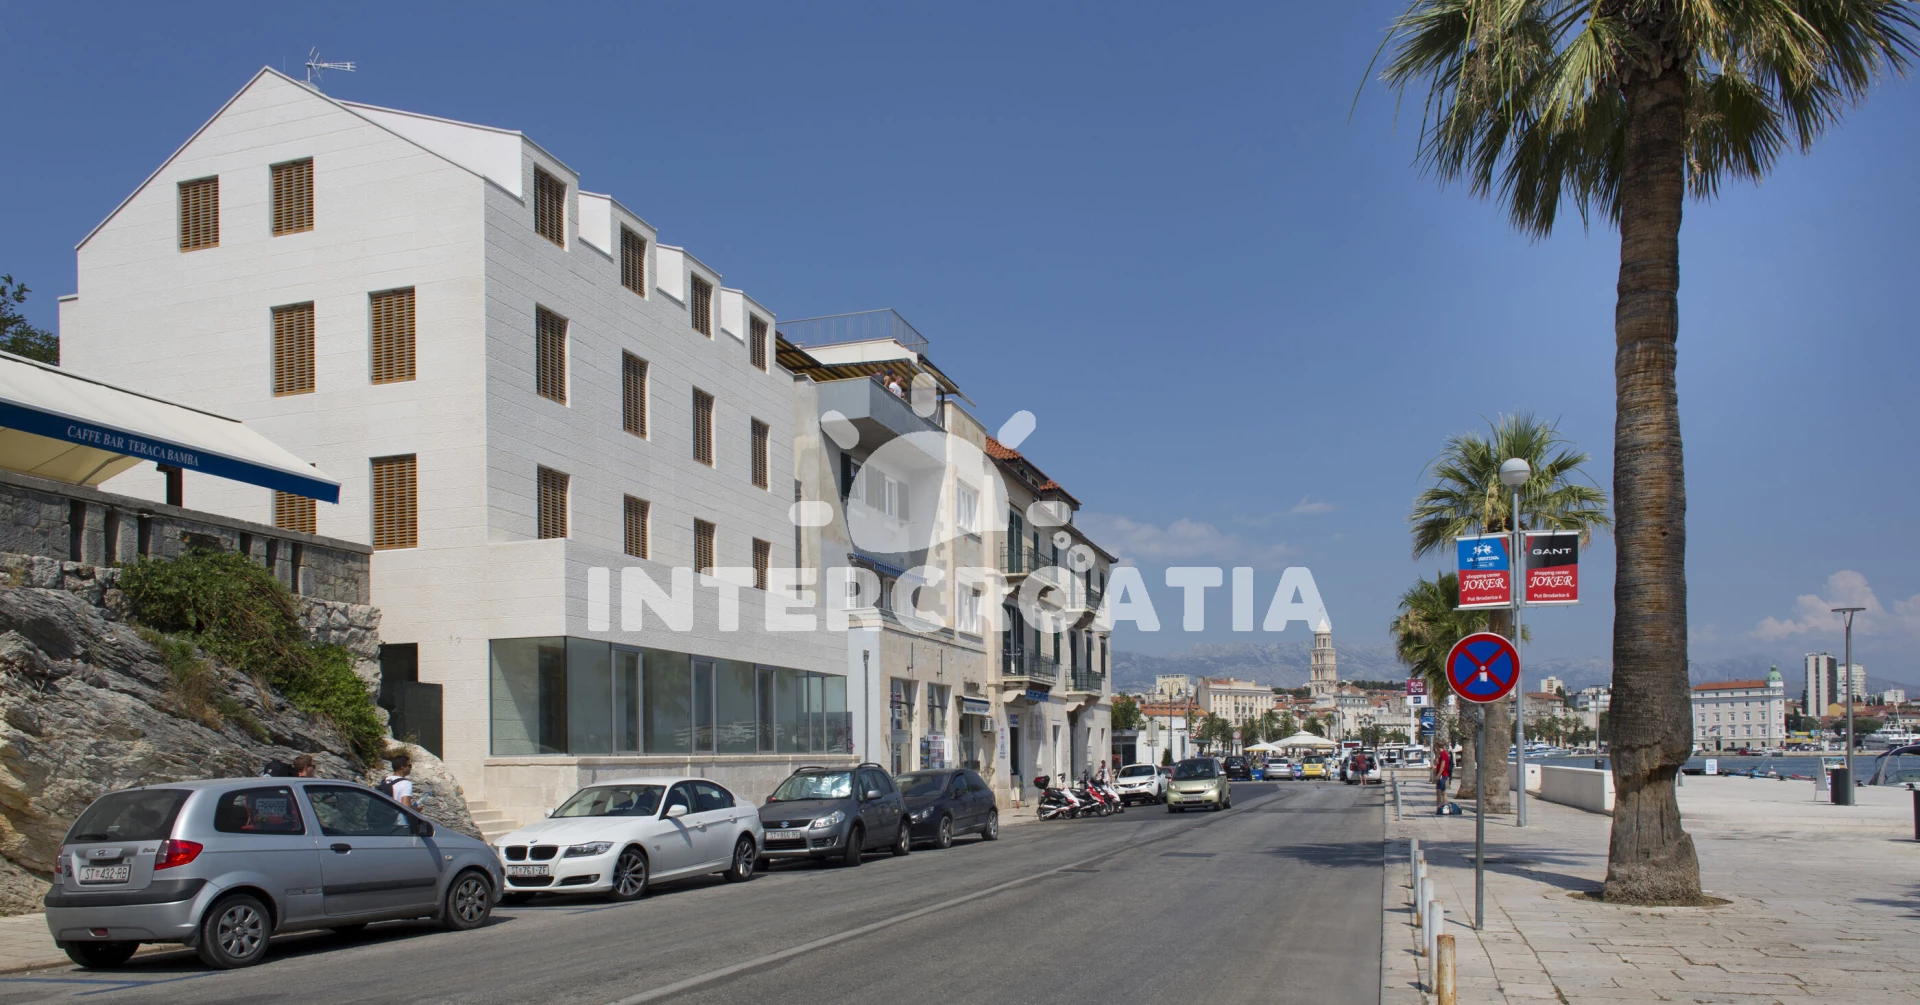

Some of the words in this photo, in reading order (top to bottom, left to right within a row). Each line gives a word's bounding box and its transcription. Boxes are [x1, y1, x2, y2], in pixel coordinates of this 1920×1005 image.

[67, 425, 102, 443] CAFFE
[103, 433, 125, 449] BAR
[128, 439, 166, 459] TERACA
[167, 449, 199, 467] BAMBA
[1532, 547, 1571, 555] GANT
[1462, 578, 1506, 591] JOKER
[1529, 575, 1575, 588] JOKER
[85, 868, 95, 880] ST
[100, 867, 128, 880] 432-RB
[512, 866, 519, 875] ST
